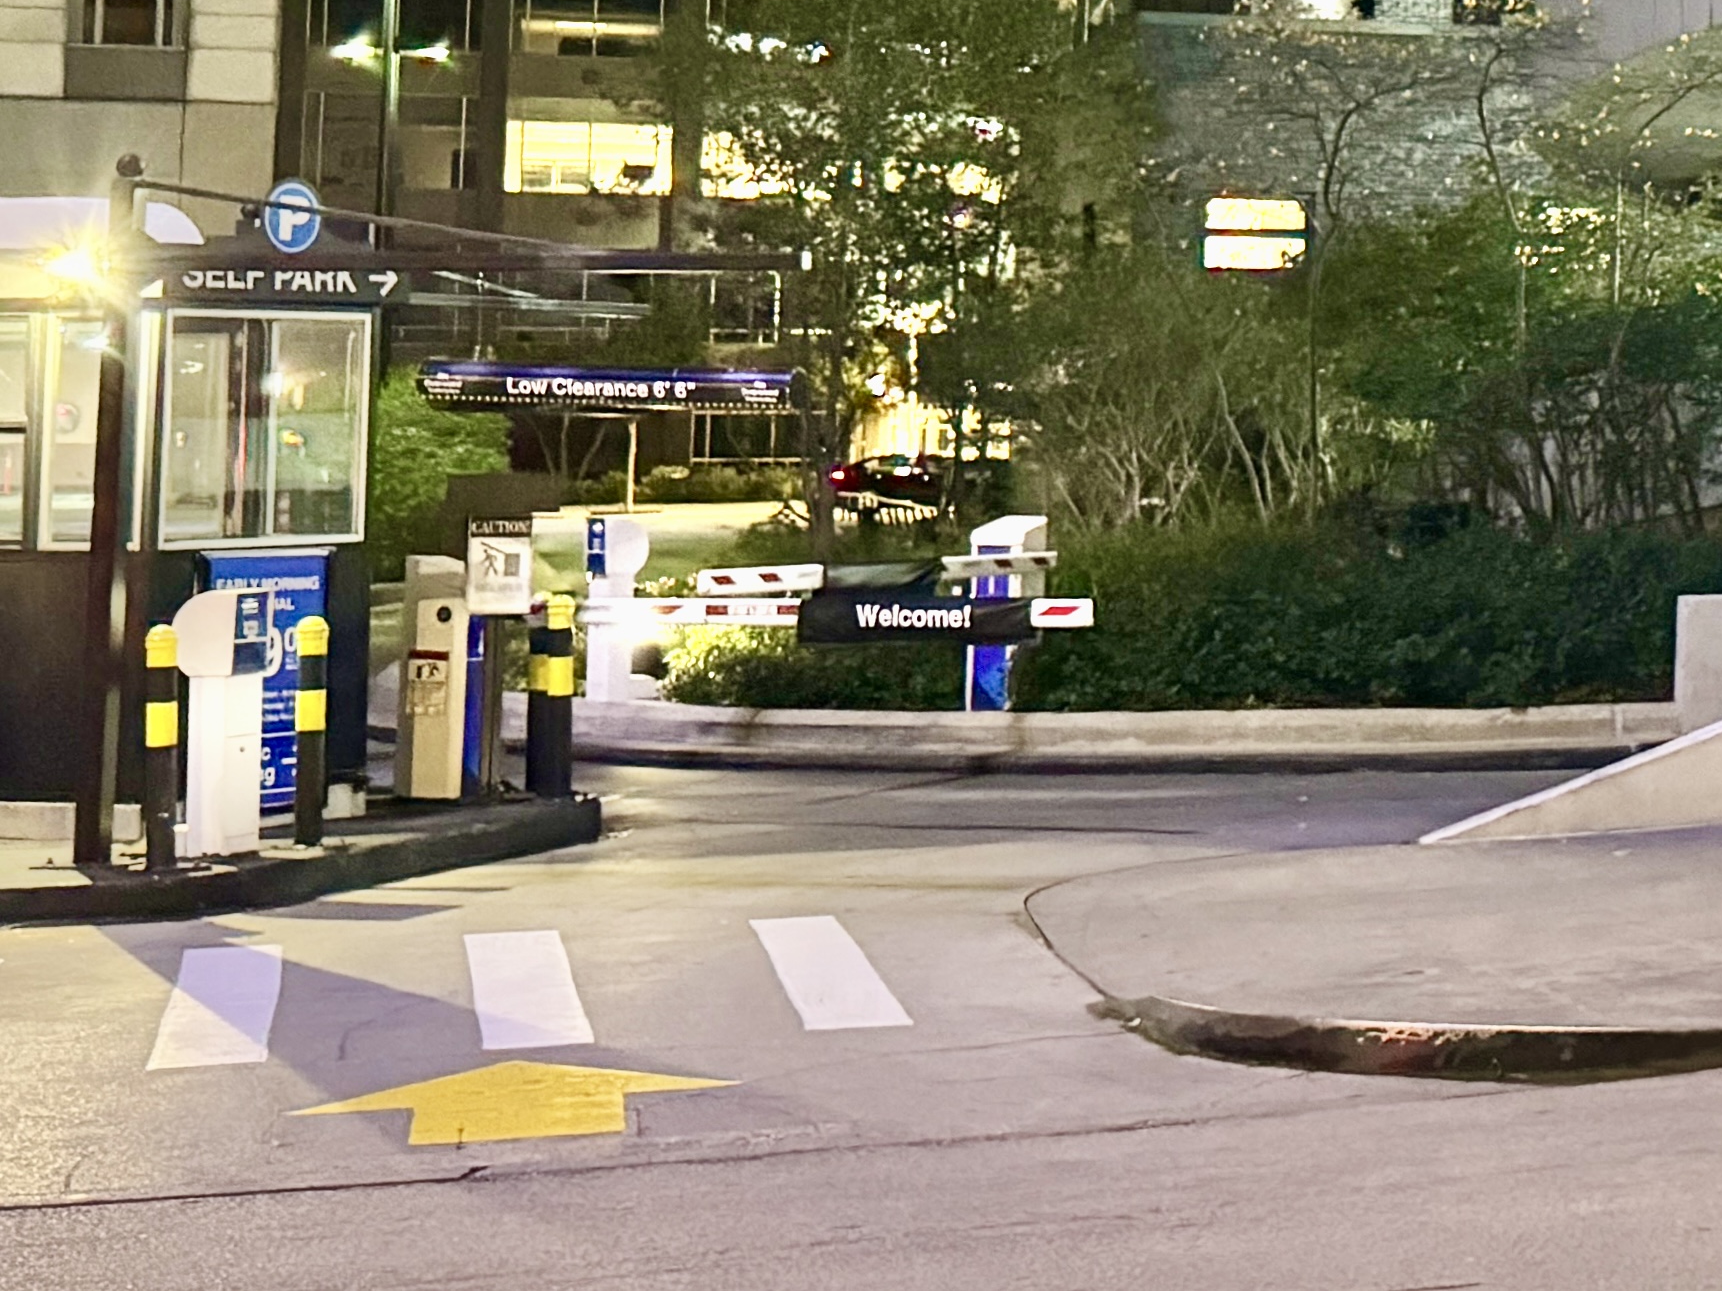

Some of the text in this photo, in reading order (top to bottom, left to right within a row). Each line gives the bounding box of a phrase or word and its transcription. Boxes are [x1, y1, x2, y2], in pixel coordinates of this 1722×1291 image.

[506, 376, 549, 395] Low
[551, 377, 649, 398] Clearance
[856, 604, 972, 628] Welcome!
